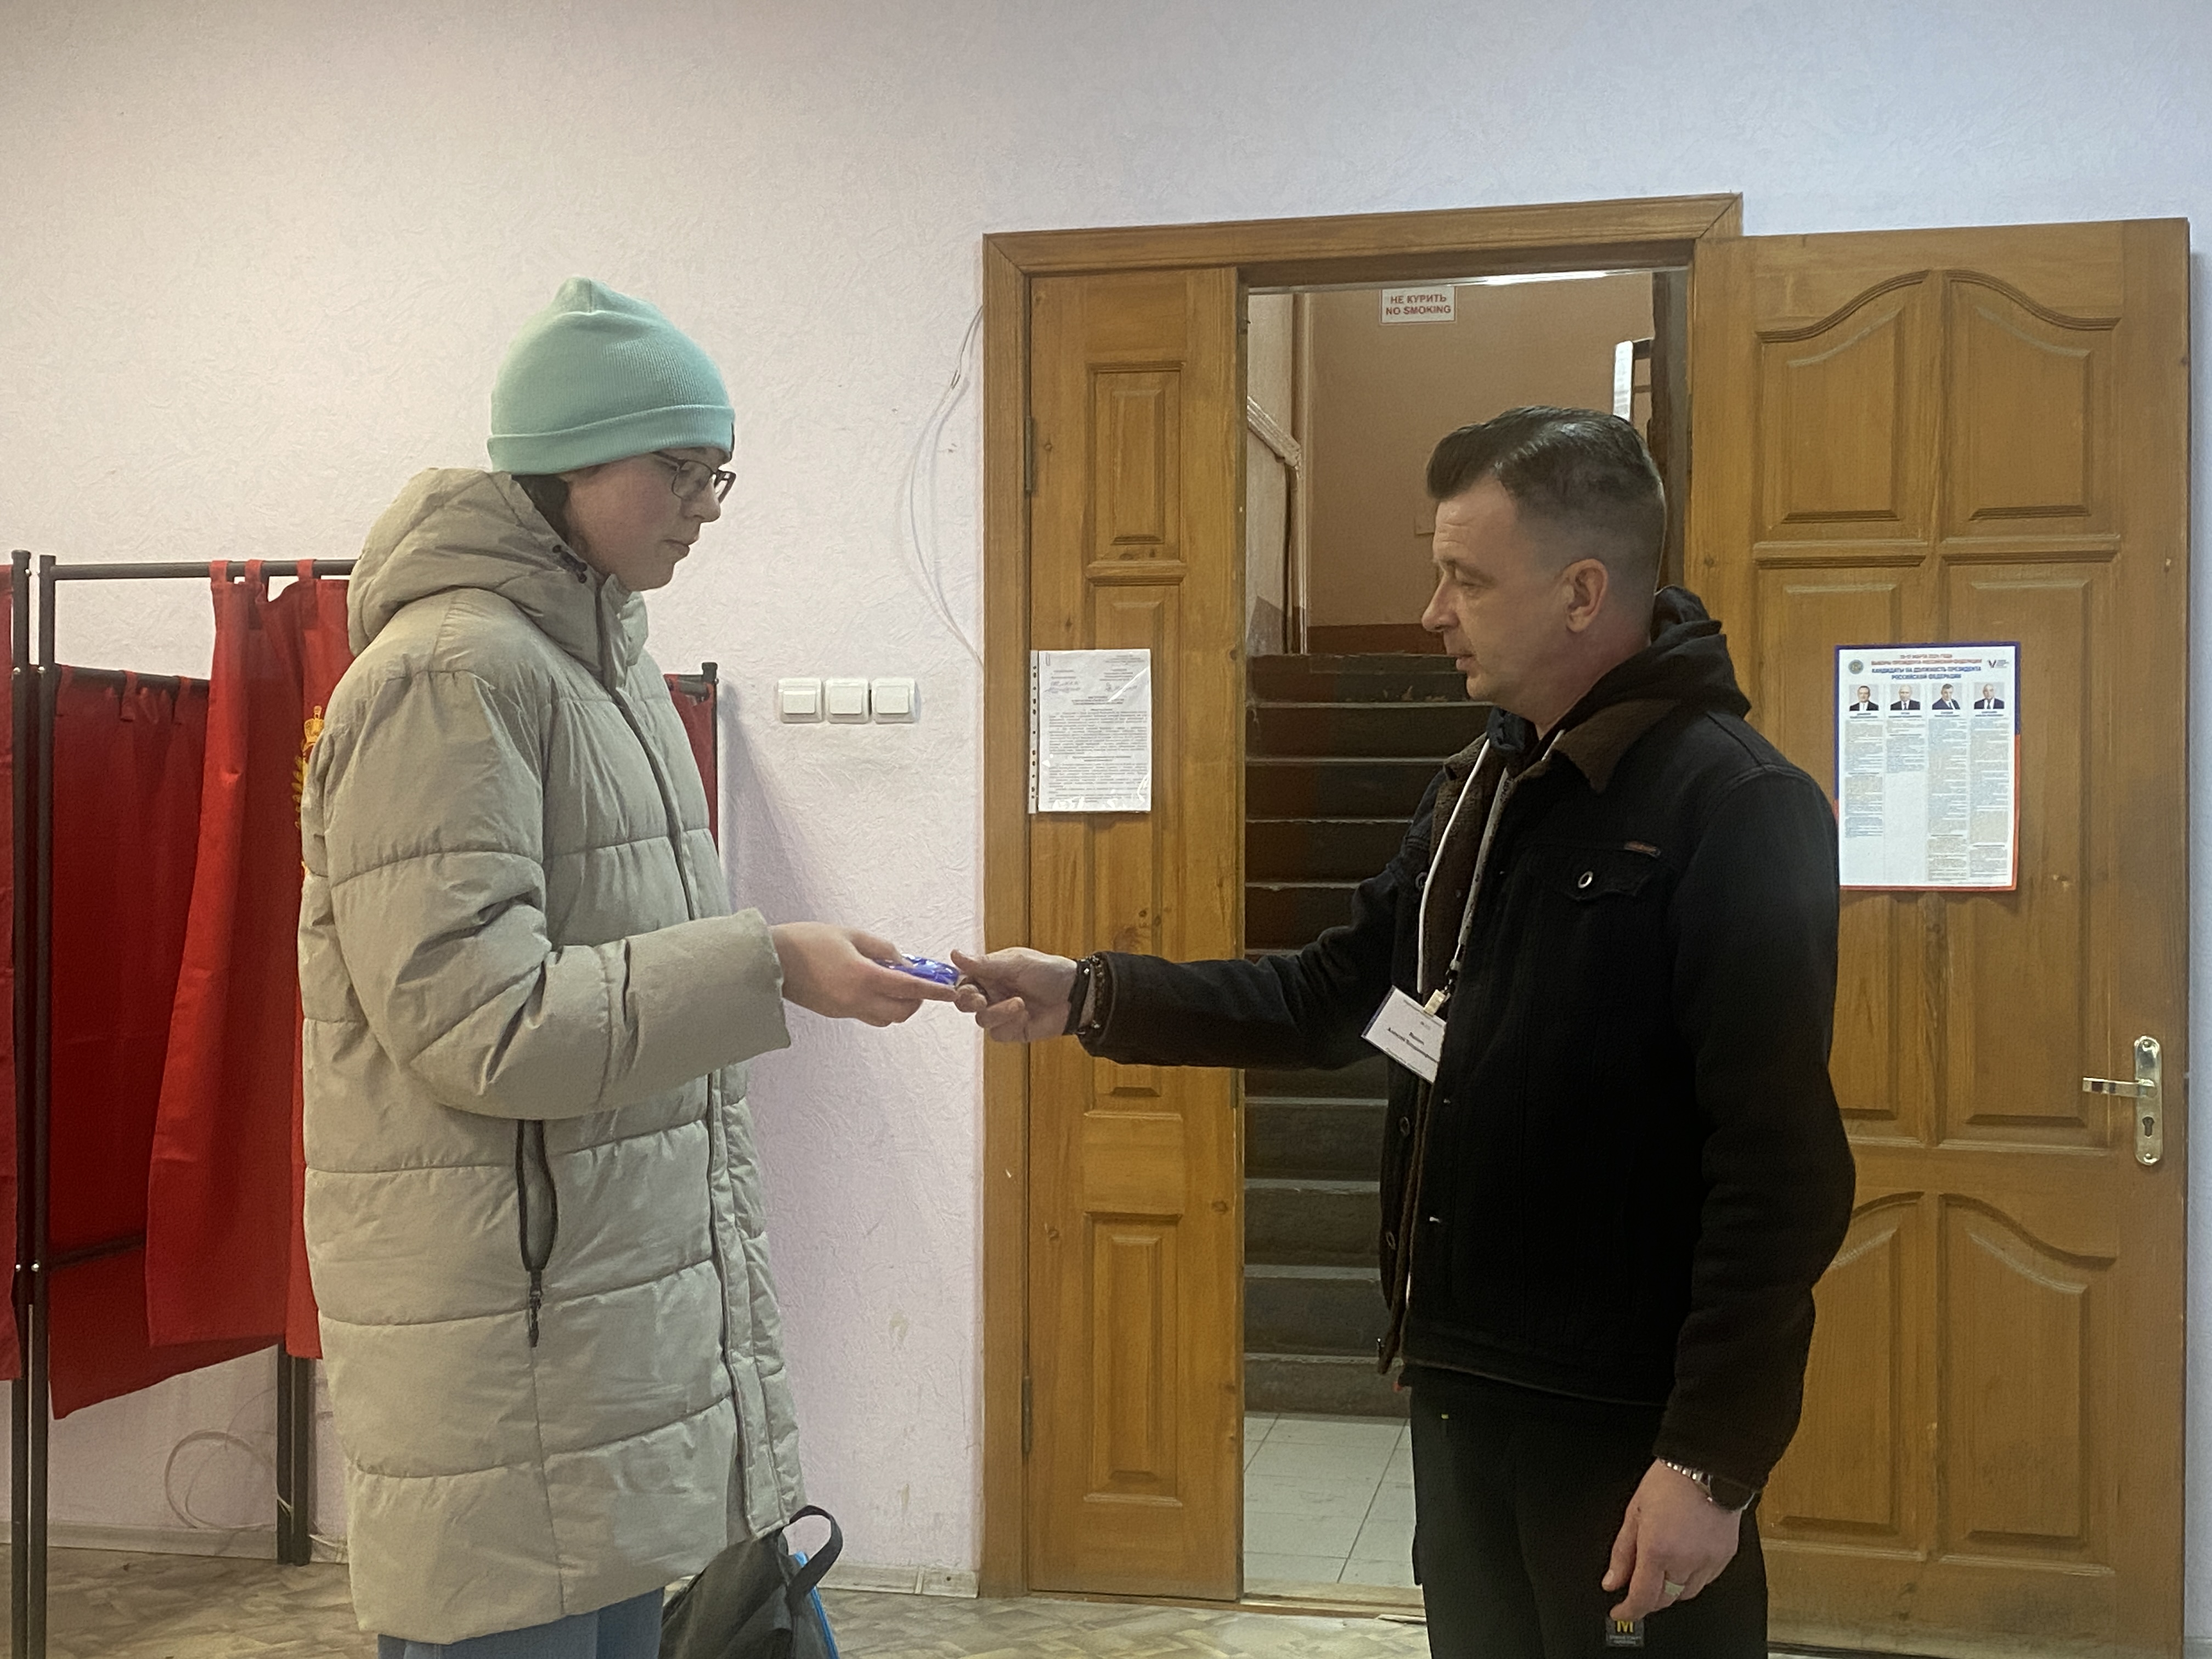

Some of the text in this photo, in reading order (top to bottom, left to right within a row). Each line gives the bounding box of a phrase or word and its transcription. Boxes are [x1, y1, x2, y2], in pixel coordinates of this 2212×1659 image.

[1390, 294, 1447, 304] НЕ КУРИТЬ
[1386, 305, 1451, 315] NO SMOKING
